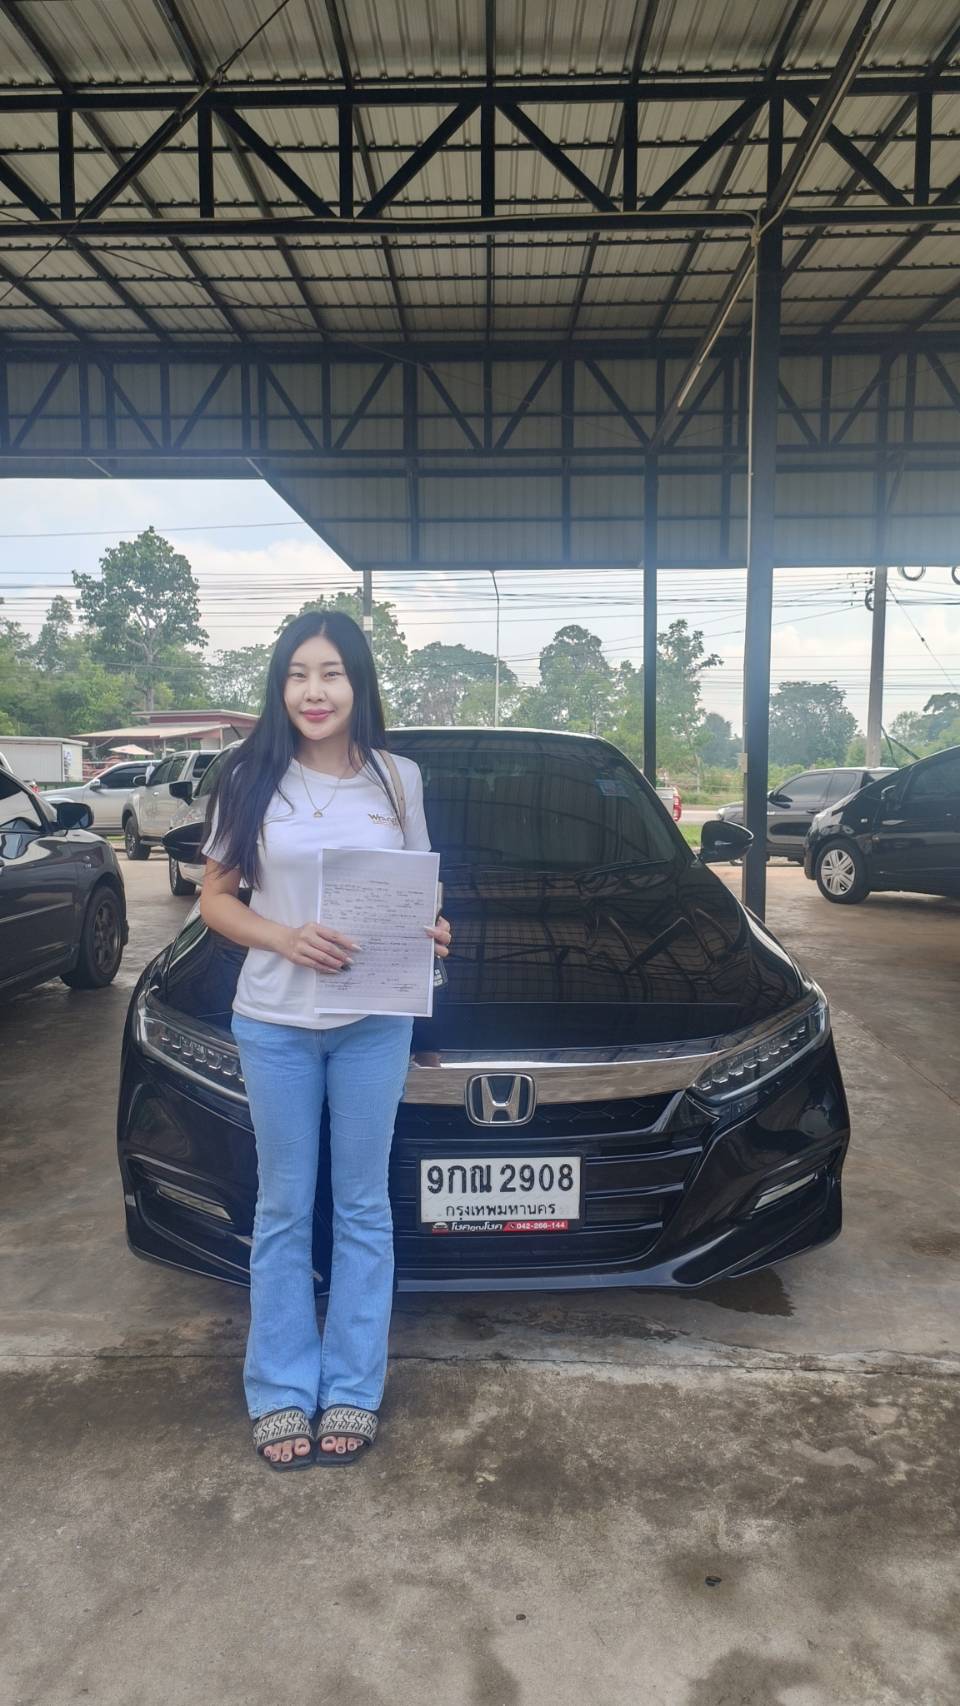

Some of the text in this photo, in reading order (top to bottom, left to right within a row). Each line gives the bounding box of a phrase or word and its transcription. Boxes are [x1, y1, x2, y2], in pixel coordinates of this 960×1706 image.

[427, 1163, 574, 1194] 9กณ 2908
[446, 1202, 556, 1220] กรุงเทพมหานคร
